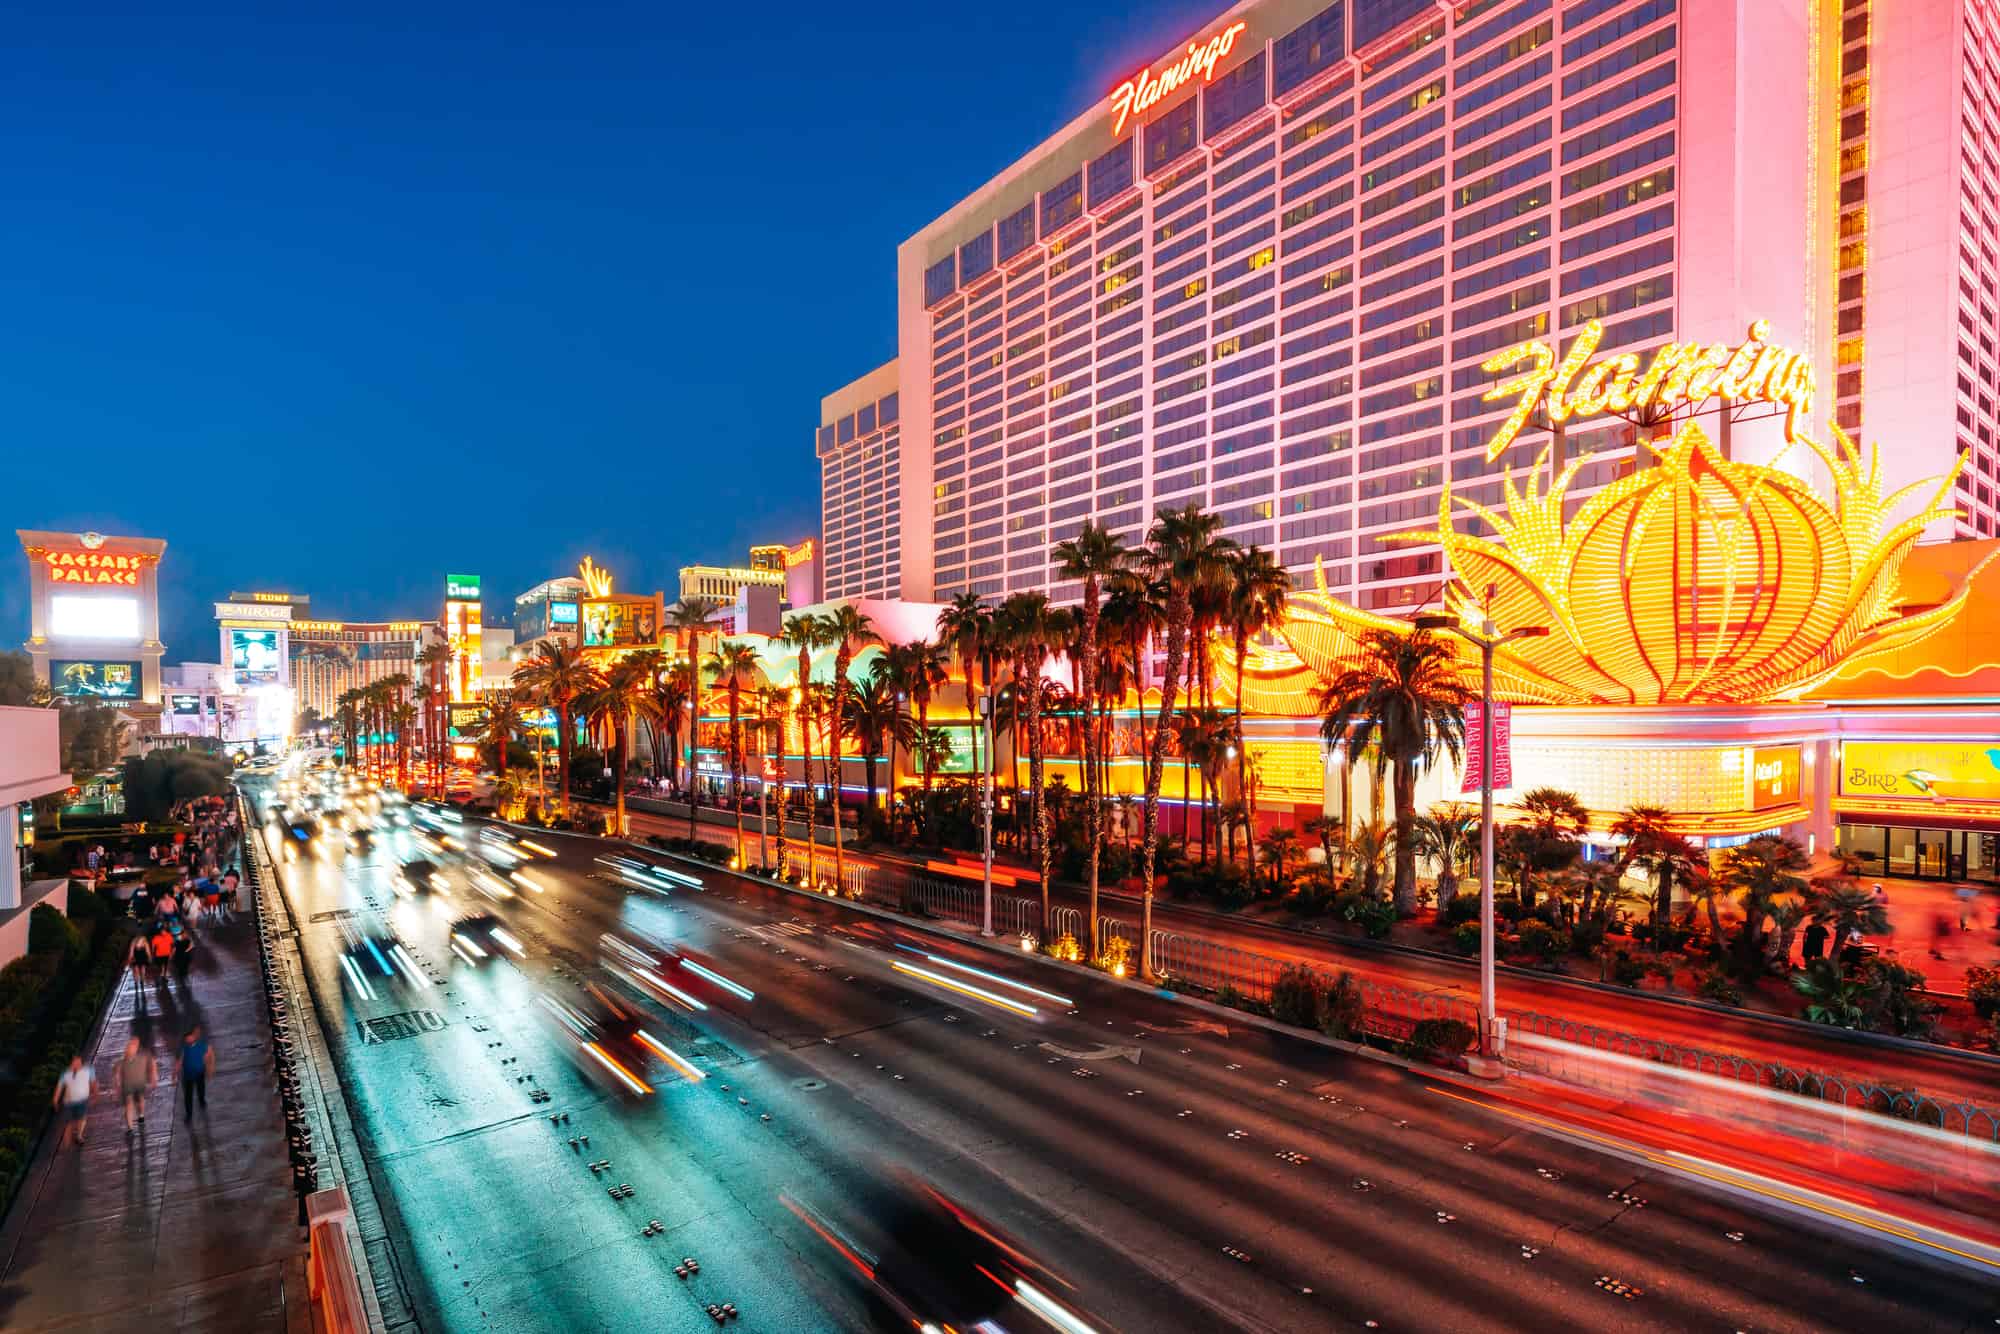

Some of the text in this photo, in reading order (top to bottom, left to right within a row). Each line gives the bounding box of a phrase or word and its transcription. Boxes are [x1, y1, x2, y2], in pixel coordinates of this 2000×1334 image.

[1110, 22, 1246, 137] Flamingo
[46, 551, 141, 570] CAESARS
[52, 569, 136, 583] PALACE
[729, 569, 785, 582] VENETIAN
[254, 593, 289, 602] TRUMP
[235, 605, 290, 617] MIRAGE
[610, 606, 652, 622] PIFF
[1495, 719, 1509, 739] LAS
[1494, 743, 1510, 782] VEGAS
